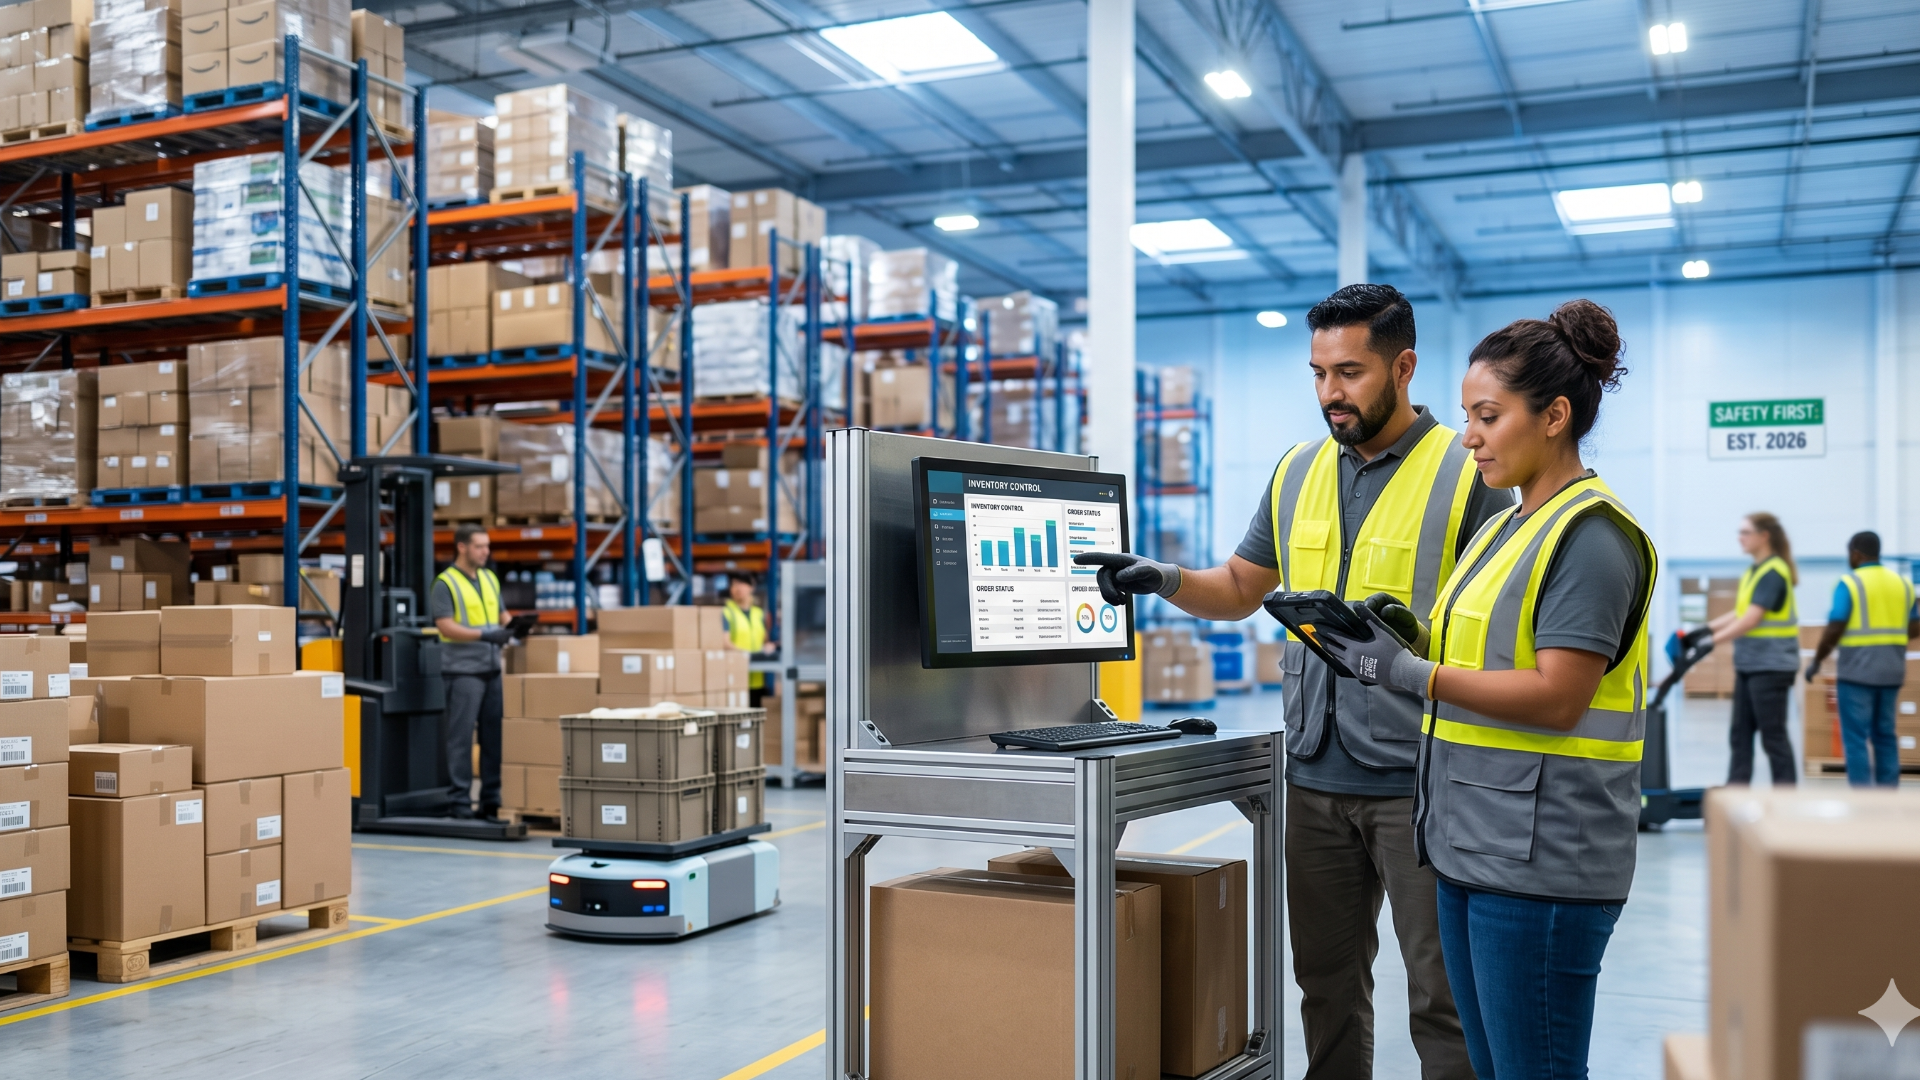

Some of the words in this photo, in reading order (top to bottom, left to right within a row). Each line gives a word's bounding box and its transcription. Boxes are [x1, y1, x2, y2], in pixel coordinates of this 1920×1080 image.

[1714, 405, 1769, 423] SAFETY
[1727, 433, 1760, 451] EST.
[1765, 431, 1807, 450] 2026
[968, 479, 1009, 490] INVENTORY
[1009, 482, 1042, 493] CONTROL
[970, 502, 1000, 511] INVENTORY
[1000, 504, 1024, 512] CONTROL
[1084, 509, 1101, 517] STATUS
